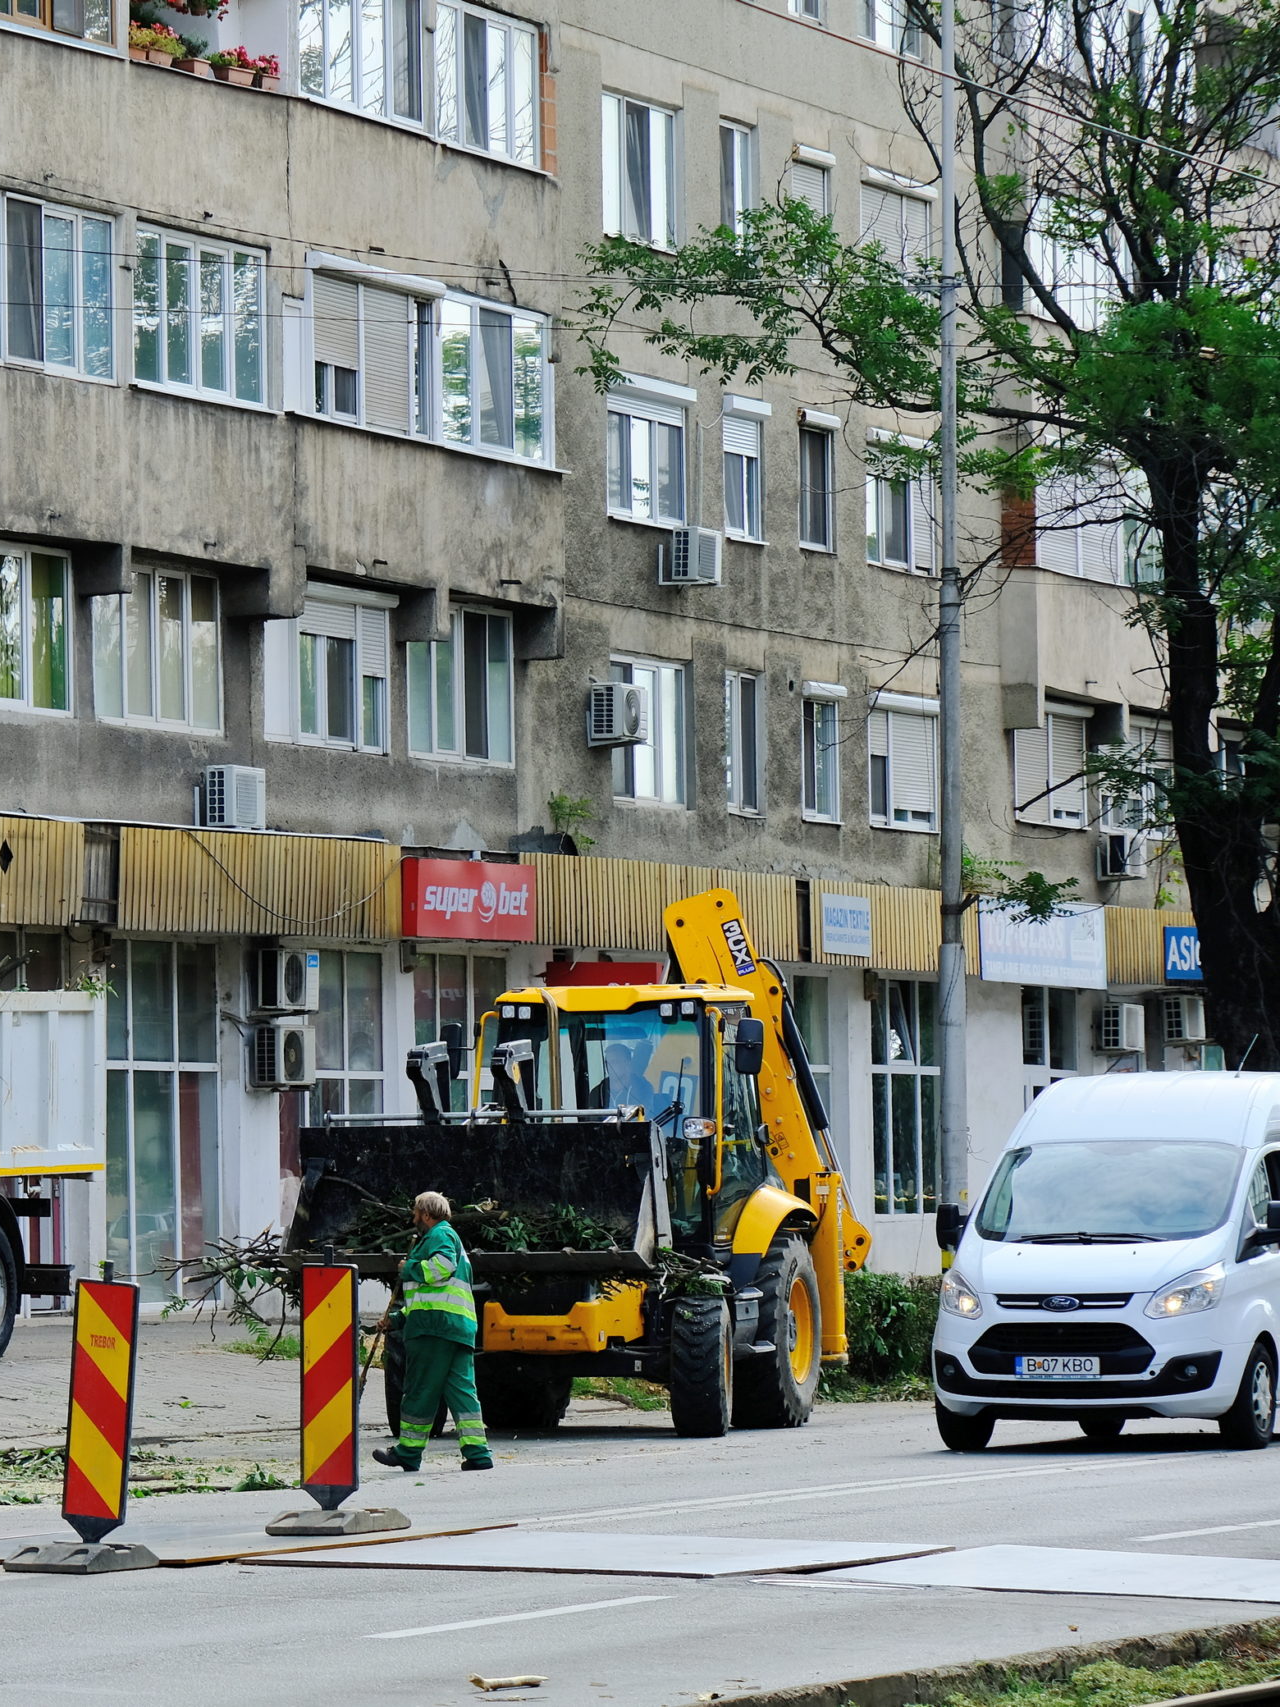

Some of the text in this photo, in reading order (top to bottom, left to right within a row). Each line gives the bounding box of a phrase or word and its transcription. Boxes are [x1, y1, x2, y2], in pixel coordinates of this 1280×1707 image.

[424, 882, 529, 920] super bet
[824, 906, 870, 931] MAGAZIN TEXTILE
[723, 920, 752, 966] 3CX
[90, 1334, 116, 1350] TREBOR
[1027, 1358, 1094, 1372] B 07 KBO
